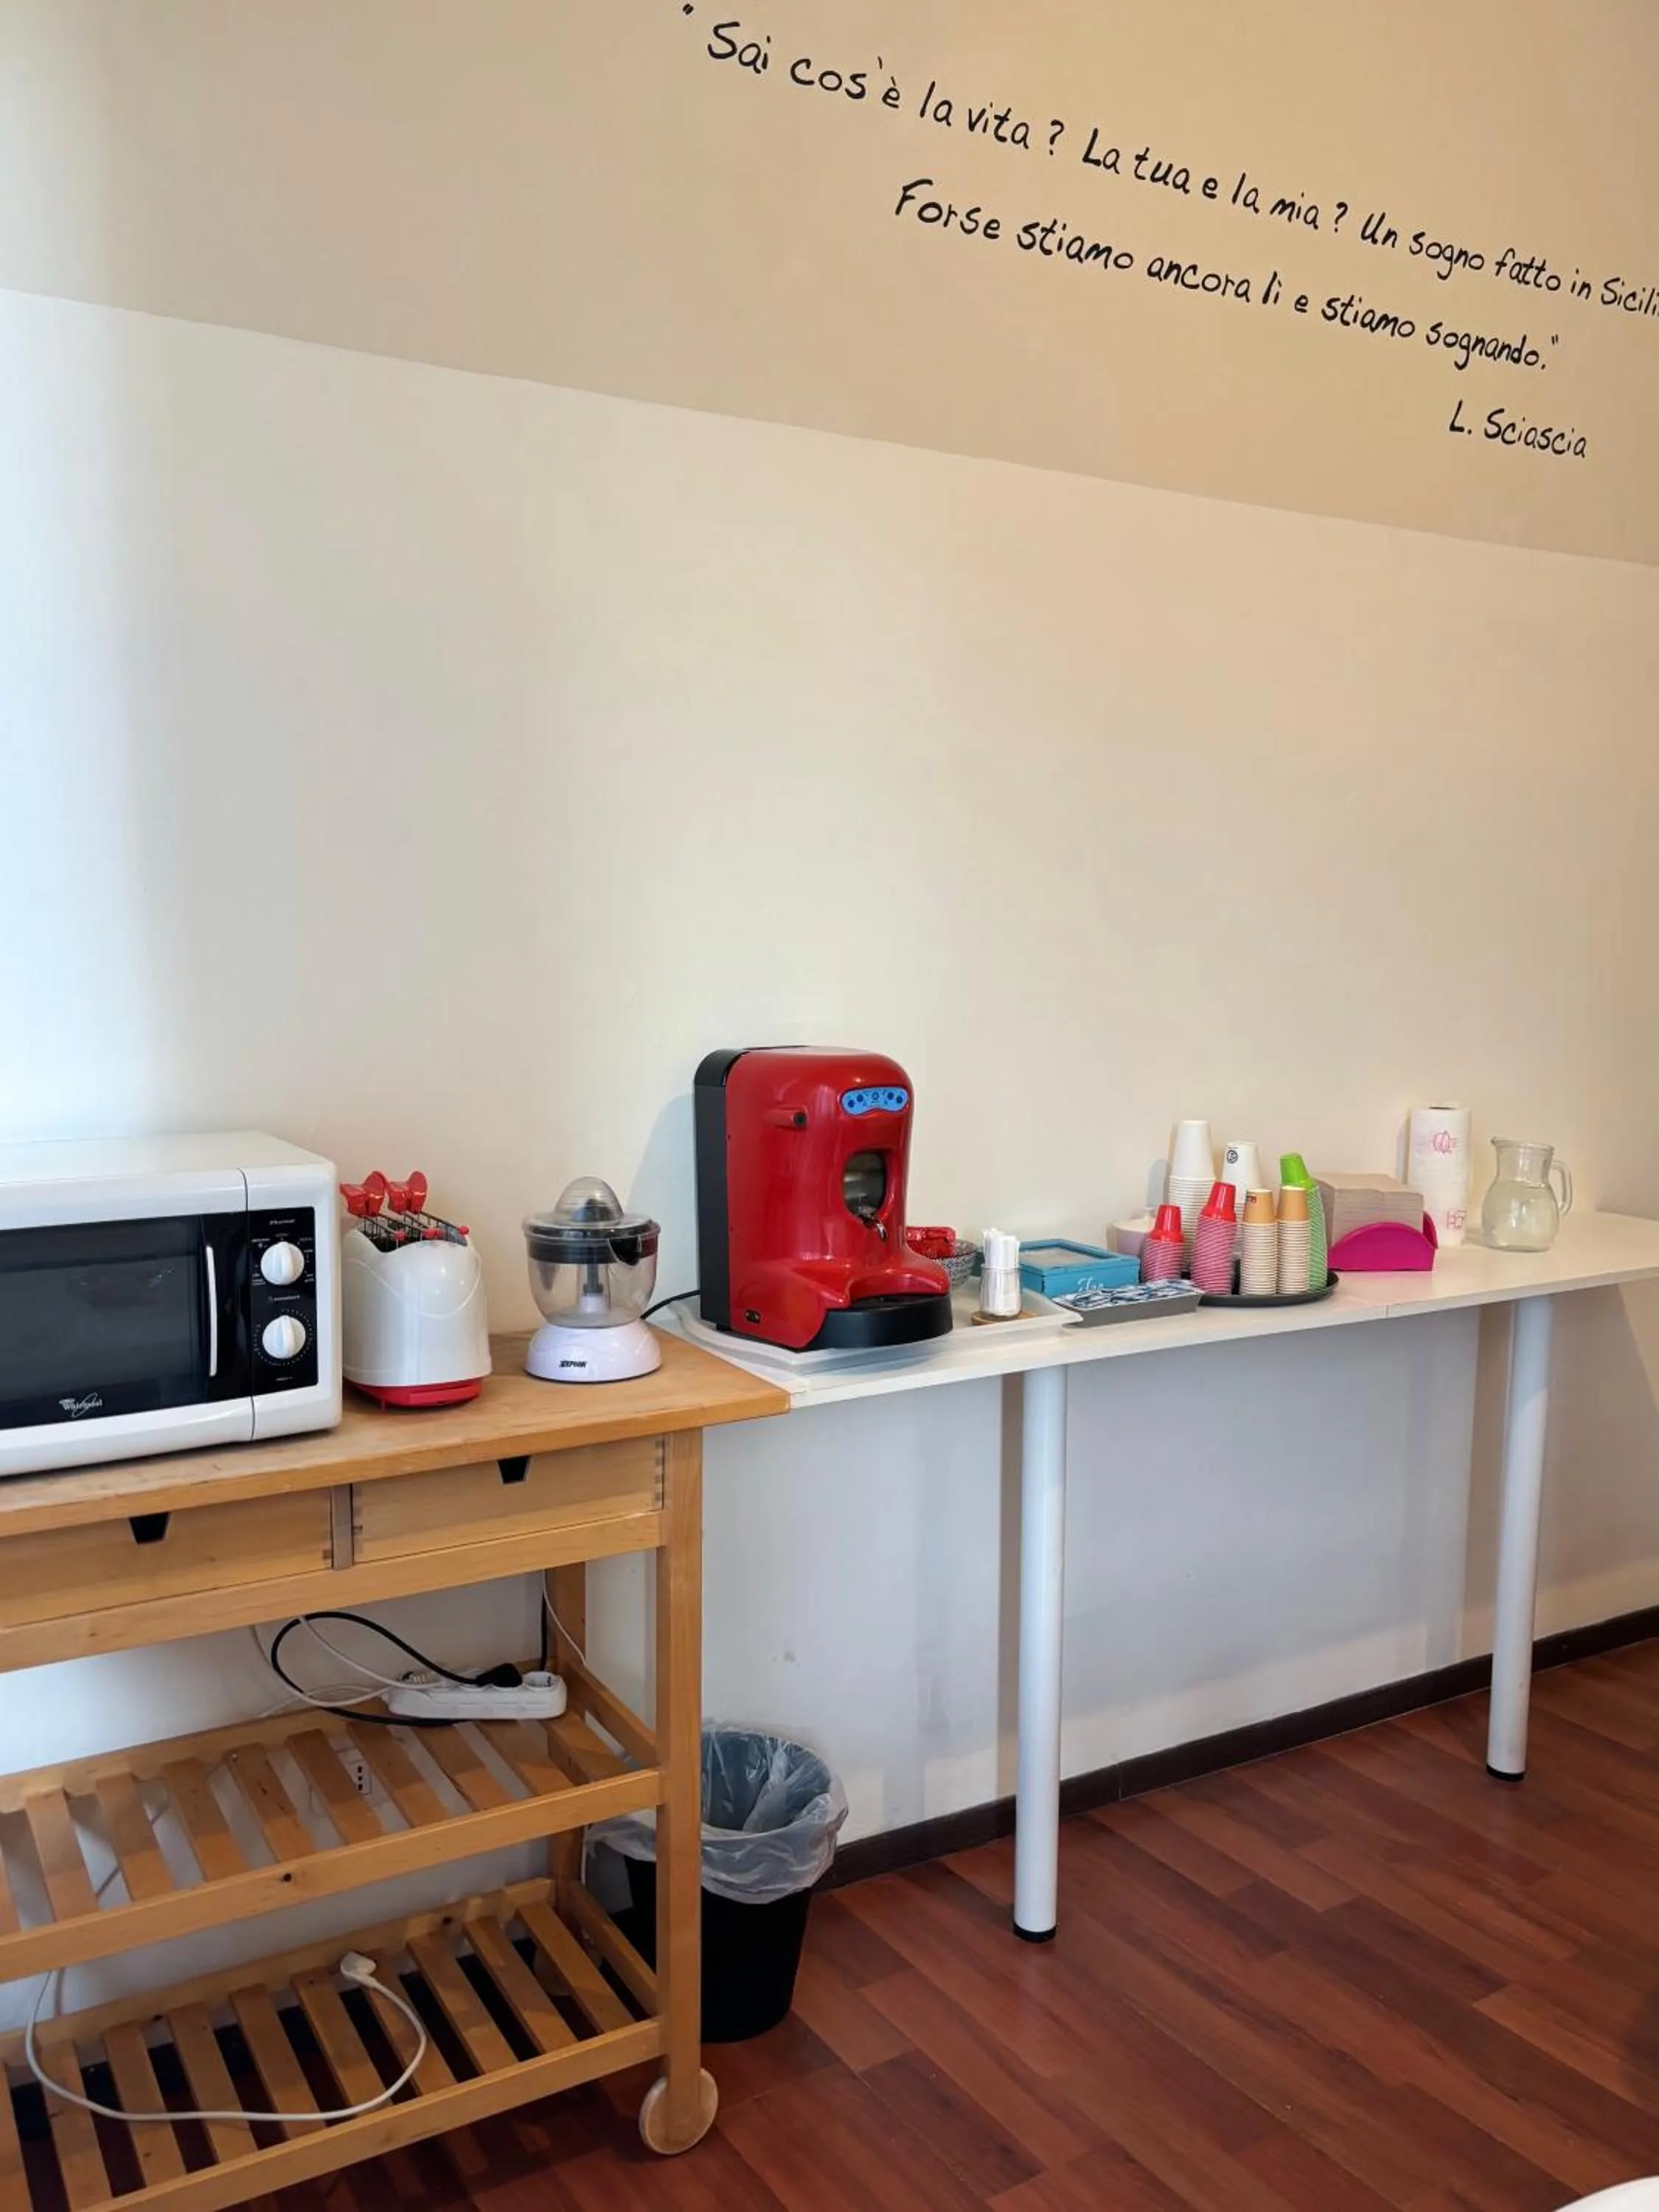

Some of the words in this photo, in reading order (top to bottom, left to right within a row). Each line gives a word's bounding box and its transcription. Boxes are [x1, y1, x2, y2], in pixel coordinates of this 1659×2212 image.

[707, 21, 771, 74] Sai
[919, 80, 953, 128] la
[1081, 127, 1121, 175] La
[1133, 146, 1191, 195] tua
[1201, 177, 1219, 200] e
[1231, 172, 1260, 215] la
[1269, 191, 1319, 231] mia
[1360, 212, 1399, 248] Un
[1408, 231, 1485, 281] sogno
[1495, 247, 1562, 291] fatto
[1570, 268, 1592, 300] in
[1600, 276, 1659, 317] Sicili
[894, 178, 1001, 240] Forse
[1015, 218, 1135, 271] stiamo
[1147, 257, 1251, 304] ancora
[1293, 294, 1310, 313] e
[1321, 294, 1416, 338] stiamo
[1449, 399, 1472, 436] L.
[1484, 407, 1587, 459] Sciascia
